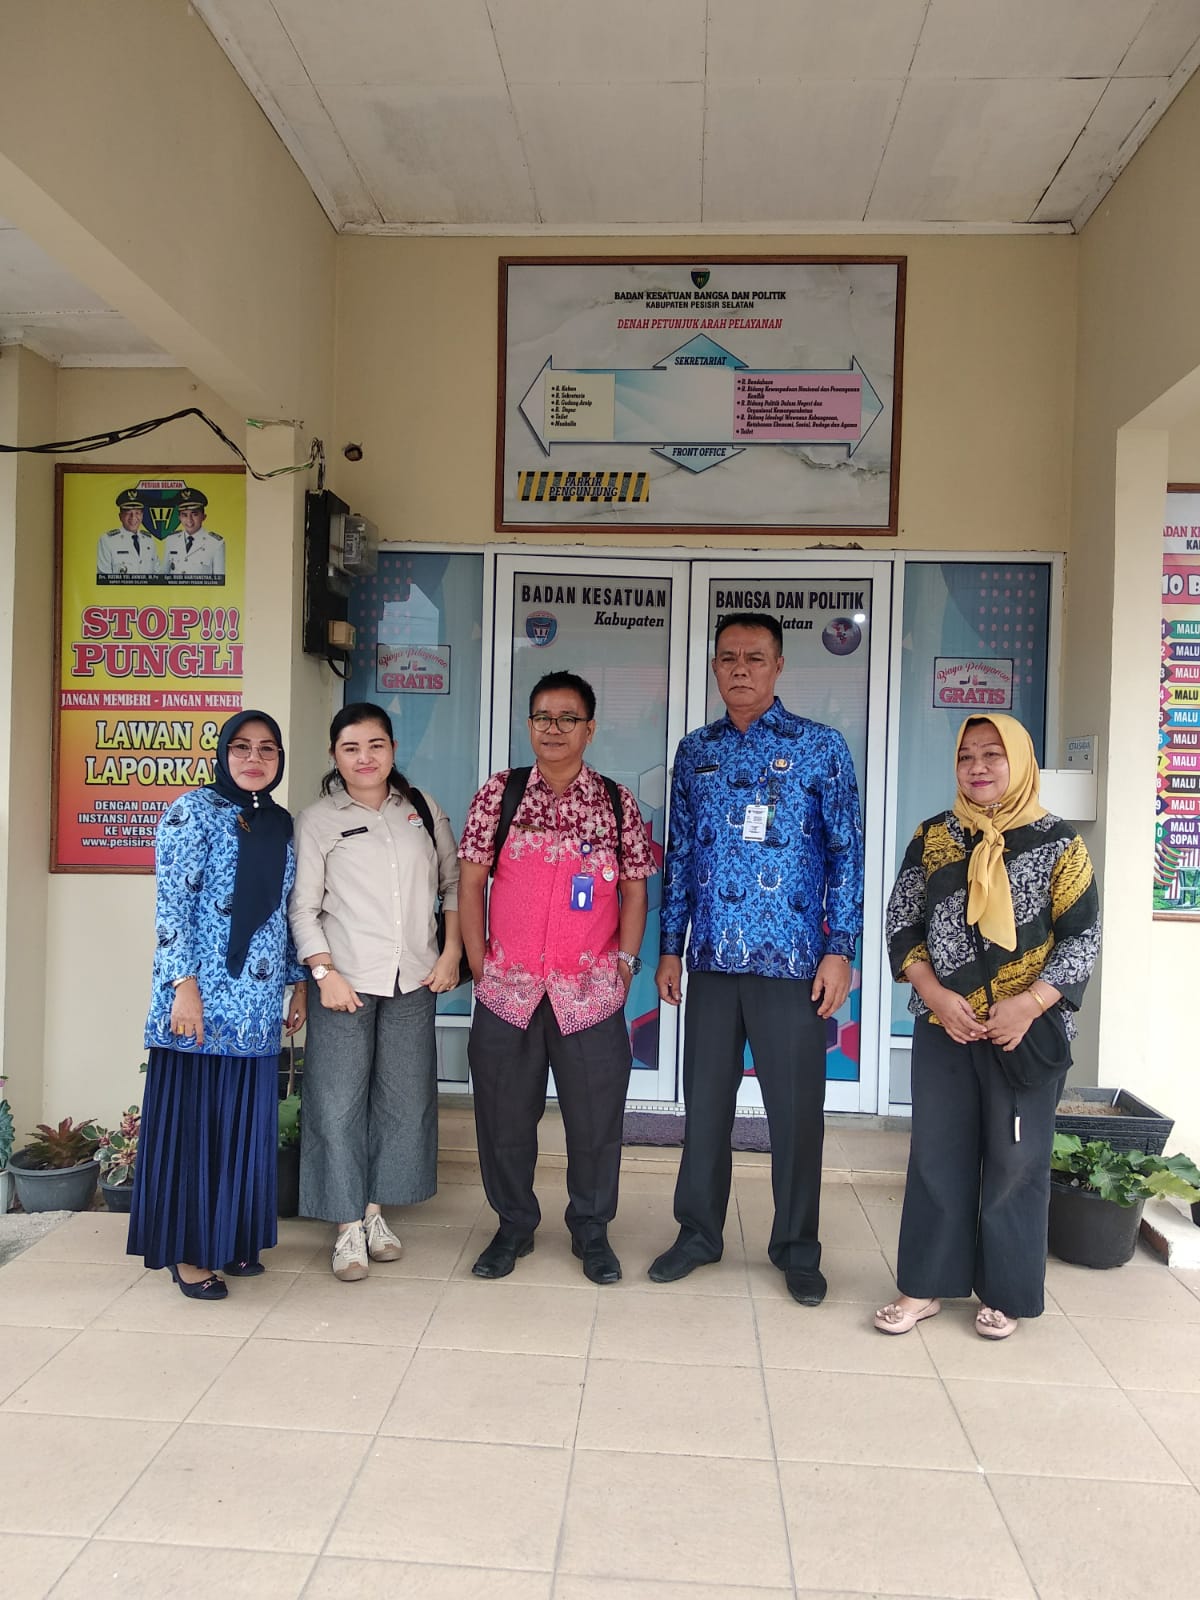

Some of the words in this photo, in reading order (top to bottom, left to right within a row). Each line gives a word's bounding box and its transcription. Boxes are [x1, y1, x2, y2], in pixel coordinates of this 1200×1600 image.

[614, 291, 644, 300] BADAN
[646, 291, 692, 300] KESATUAN
[695, 291, 729, 300] BANGSA
[731, 291, 750, 300] DAN
[752, 291, 786, 300] POLITIK
[617, 318, 649, 329] DENAH
[651, 318, 700, 329] PETUNJUK
[700, 318, 726, 329] ARAH
[728, 318, 783, 329] PELAYANAN
[674, 356, 728, 366] SEKRETARIAT
[672, 448, 699, 457] FRONT
[700, 448, 726, 457] OFFICE
[564, 477, 602, 486] PARKIR
[549, 486, 618, 497] PENGUNJUNG
[1186, 539, 1200, 550] KA
[522, 585, 576, 604] BADAN
[582, 587, 666, 608] KESATUAN
[716, 590, 771, 609] BANGSA
[776, 592, 804, 609] DAN
[810, 592, 864, 610] POLITIK
[82, 606, 240, 640] STOP!!!
[594, 610, 665, 629] Kabupaten
[779, 615, 813, 630] latan
[1176, 624, 1200, 634] MALU
[1176, 646, 1200, 656] MALU
[72, 642, 243, 678] PUNGLI
[966, 661, 1010, 682] Pelayanan
[1175, 668, 1199, 678] MALU
[382, 672, 444, 690] GRATIS
[61, 693, 100, 706] JANGAN
[103, 694, 151, 706] MEMBERI
[162, 694, 202, 708] JANGAN
[939, 686, 1006, 704] GRATIS
[1174, 690, 1198, 700] MALU
[1174, 712, 1198, 722] MALU
[96, 720, 194, 750] LAWAN
[200, 720, 220, 751] &
[1173, 734, 1198, 744] MALU
[1172, 756, 1197, 766] MALU
[1172, 778, 1196, 788] MALU
[95, 801, 138, 812] DENGAN
[142, 801, 168, 812] DATA
[1171, 800, 1196, 810] MALU
[78, 813, 128, 824] INSTANSI
[130, 814, 158, 824] ATAU
[104, 826, 118, 836] KE
[1170, 822, 1195, 832] MALU
[1170, 834, 1198, 845] SOPAN
